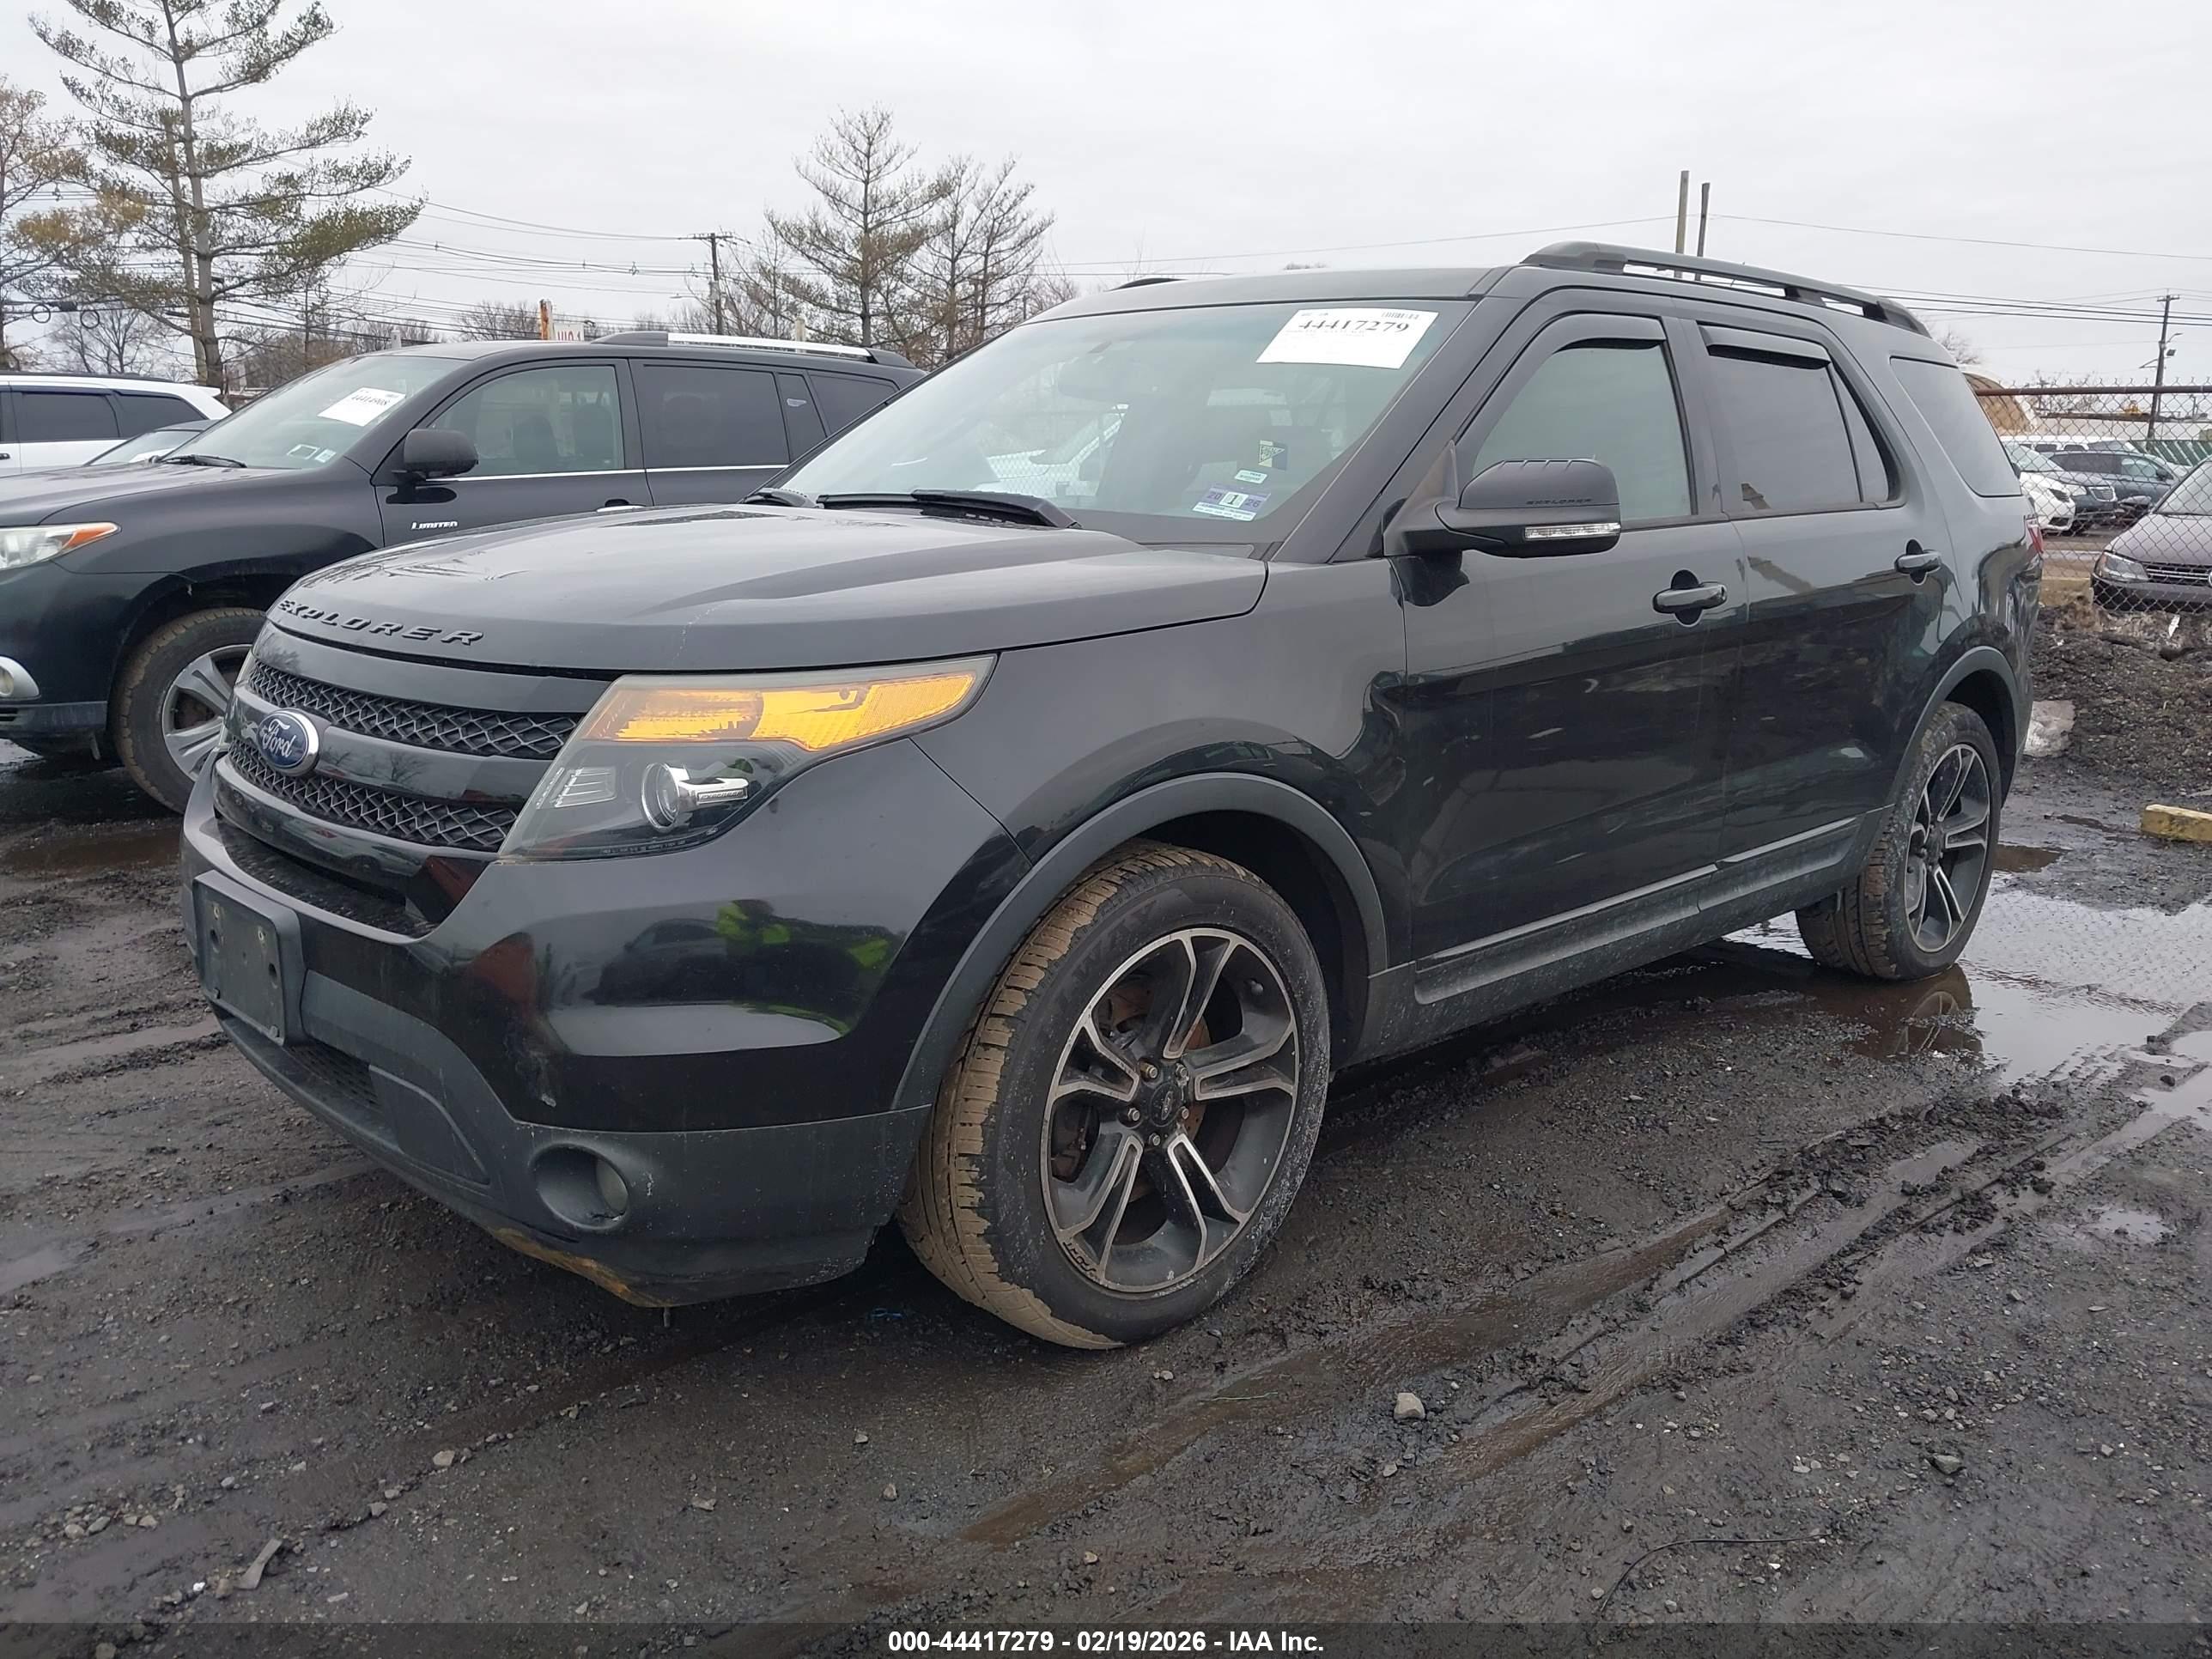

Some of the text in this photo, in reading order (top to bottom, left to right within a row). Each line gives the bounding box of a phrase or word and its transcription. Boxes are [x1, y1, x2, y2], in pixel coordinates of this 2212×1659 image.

[1298, 319, 1409, 332] 44417279
[1227, 494, 1239, 505] 1
[277, 599, 483, 646] EXPLORER
[259, 718, 299, 757] Ford
